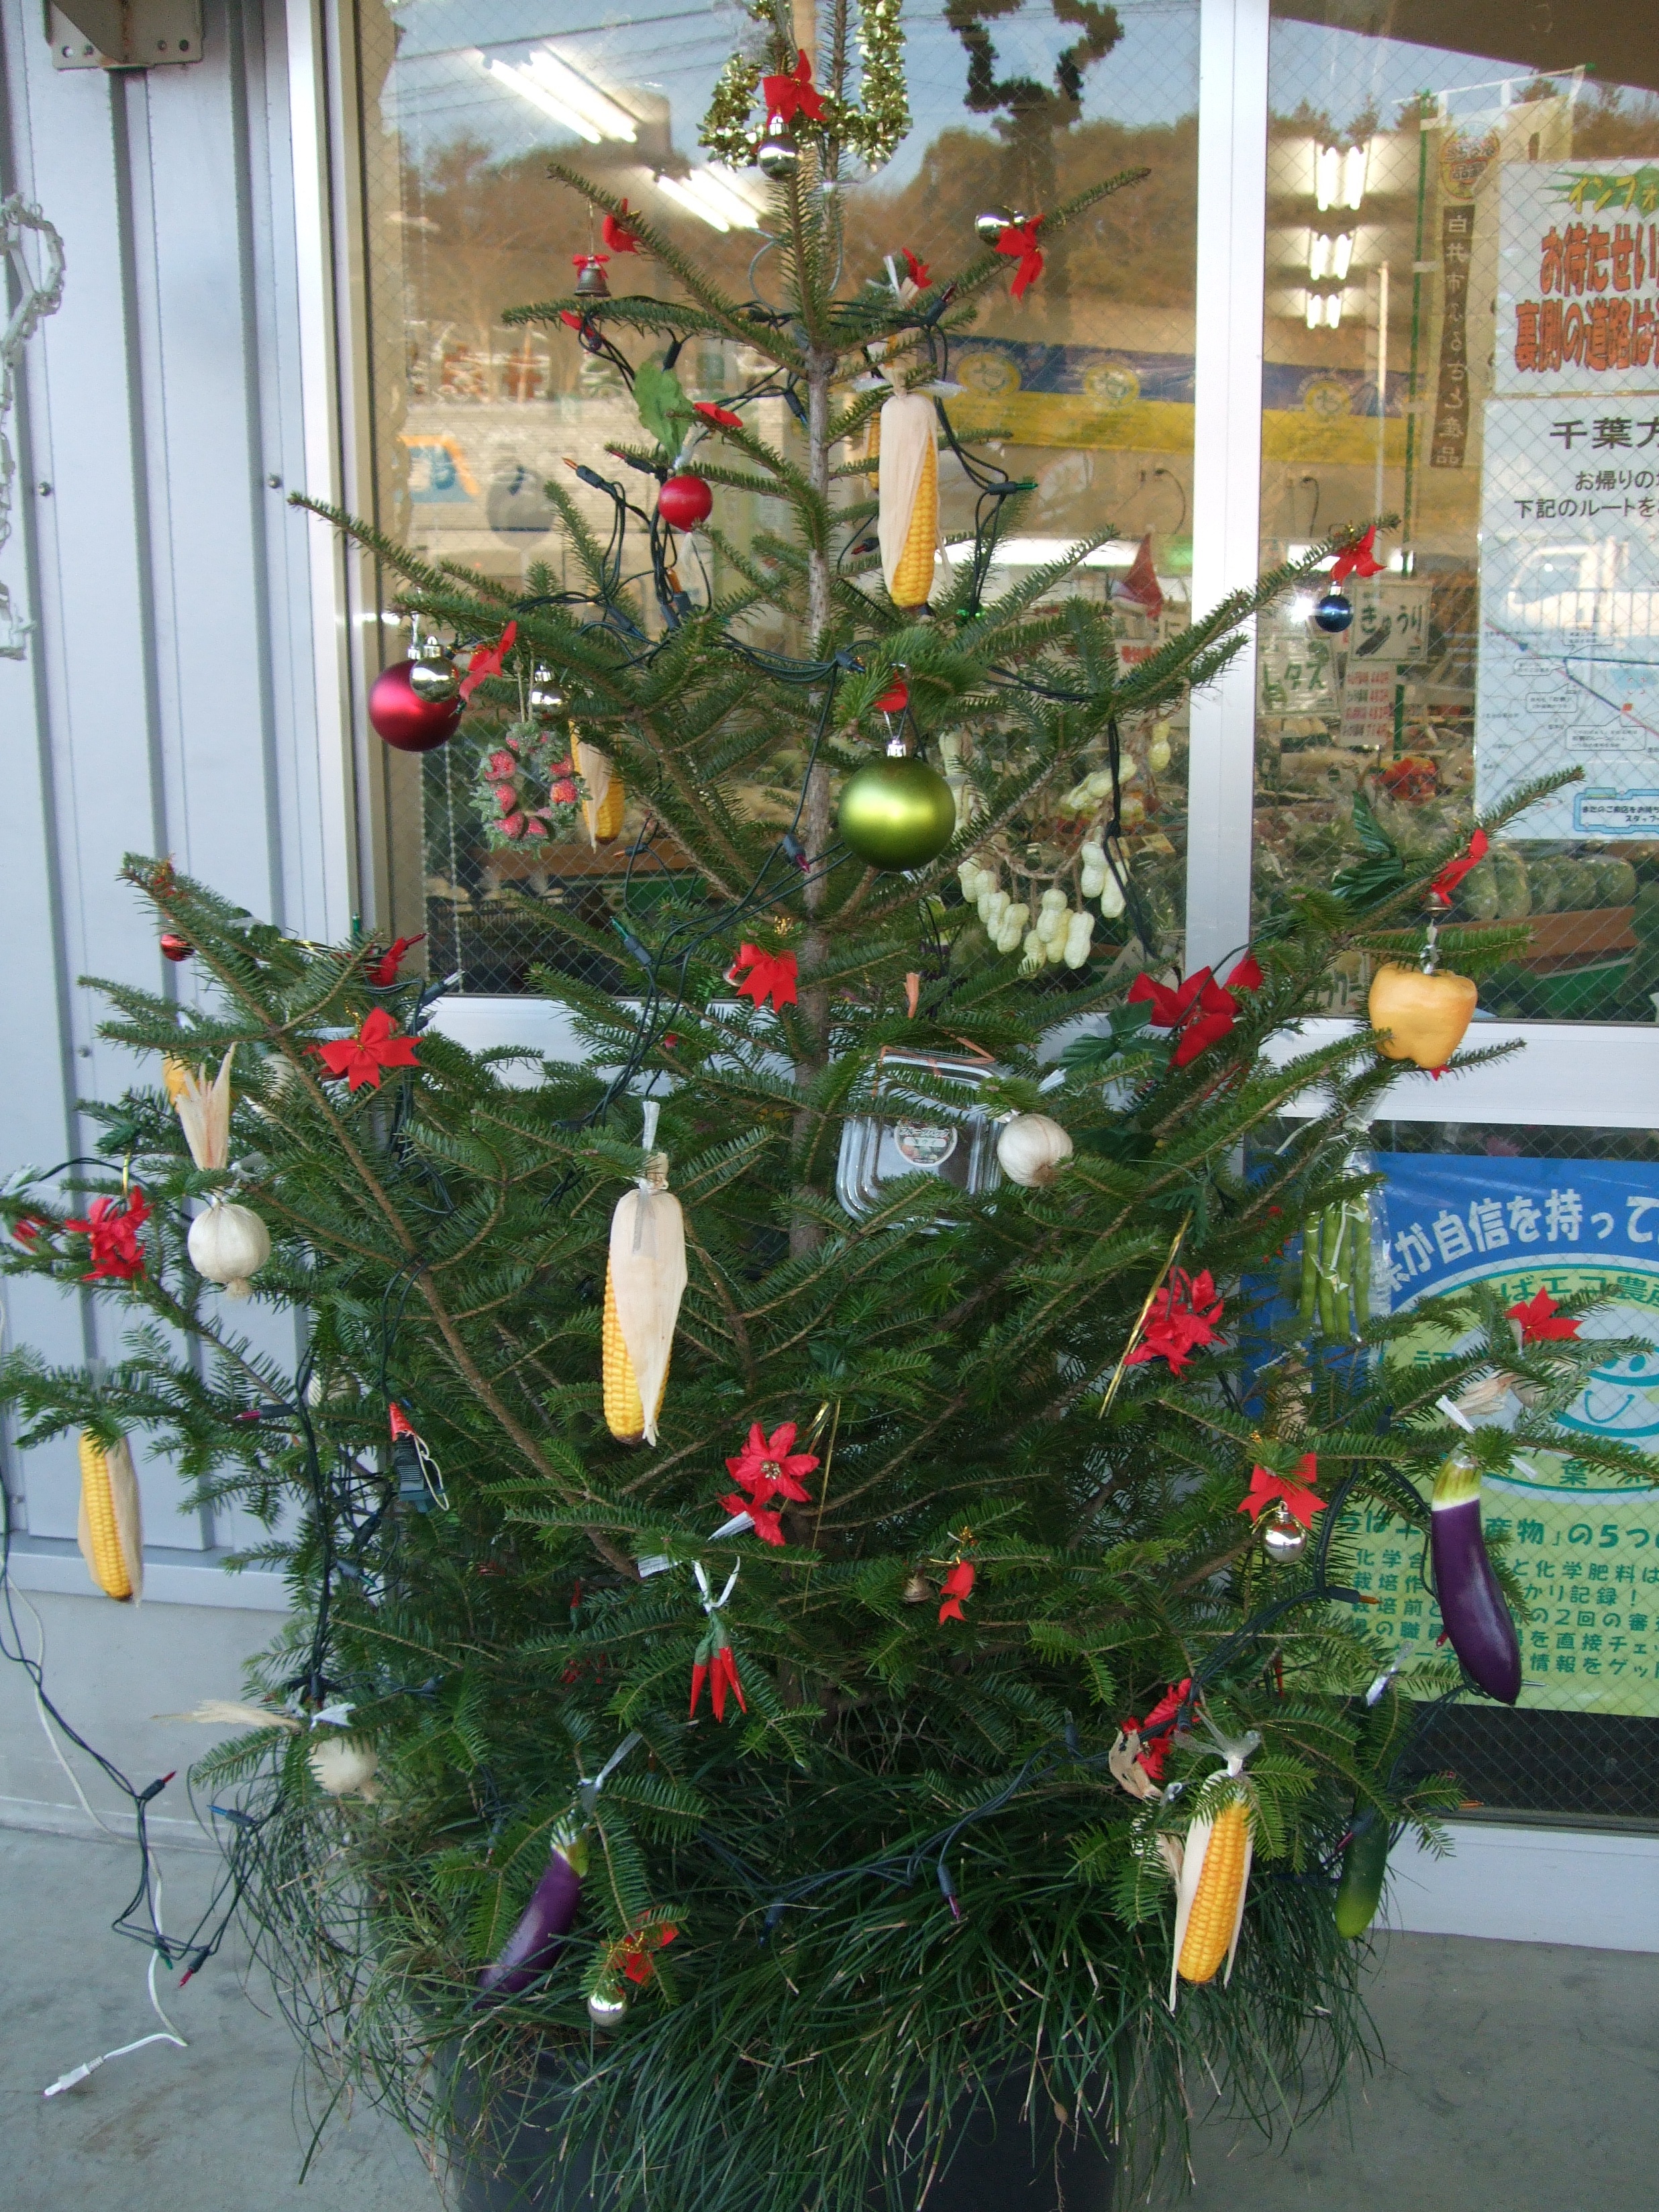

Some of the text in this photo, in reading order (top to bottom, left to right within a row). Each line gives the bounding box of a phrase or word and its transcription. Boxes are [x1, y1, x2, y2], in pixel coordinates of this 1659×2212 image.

[1540, 221, 1659, 297] お待たせい
[1515, 297, 1659, 372] 裏側の道路は
[1513, 496, 1659, 519] 下記のルートを
[1575, 470, 1659, 491] お帰りの
[1381, 1188, 1659, 1293] が自信を持って
